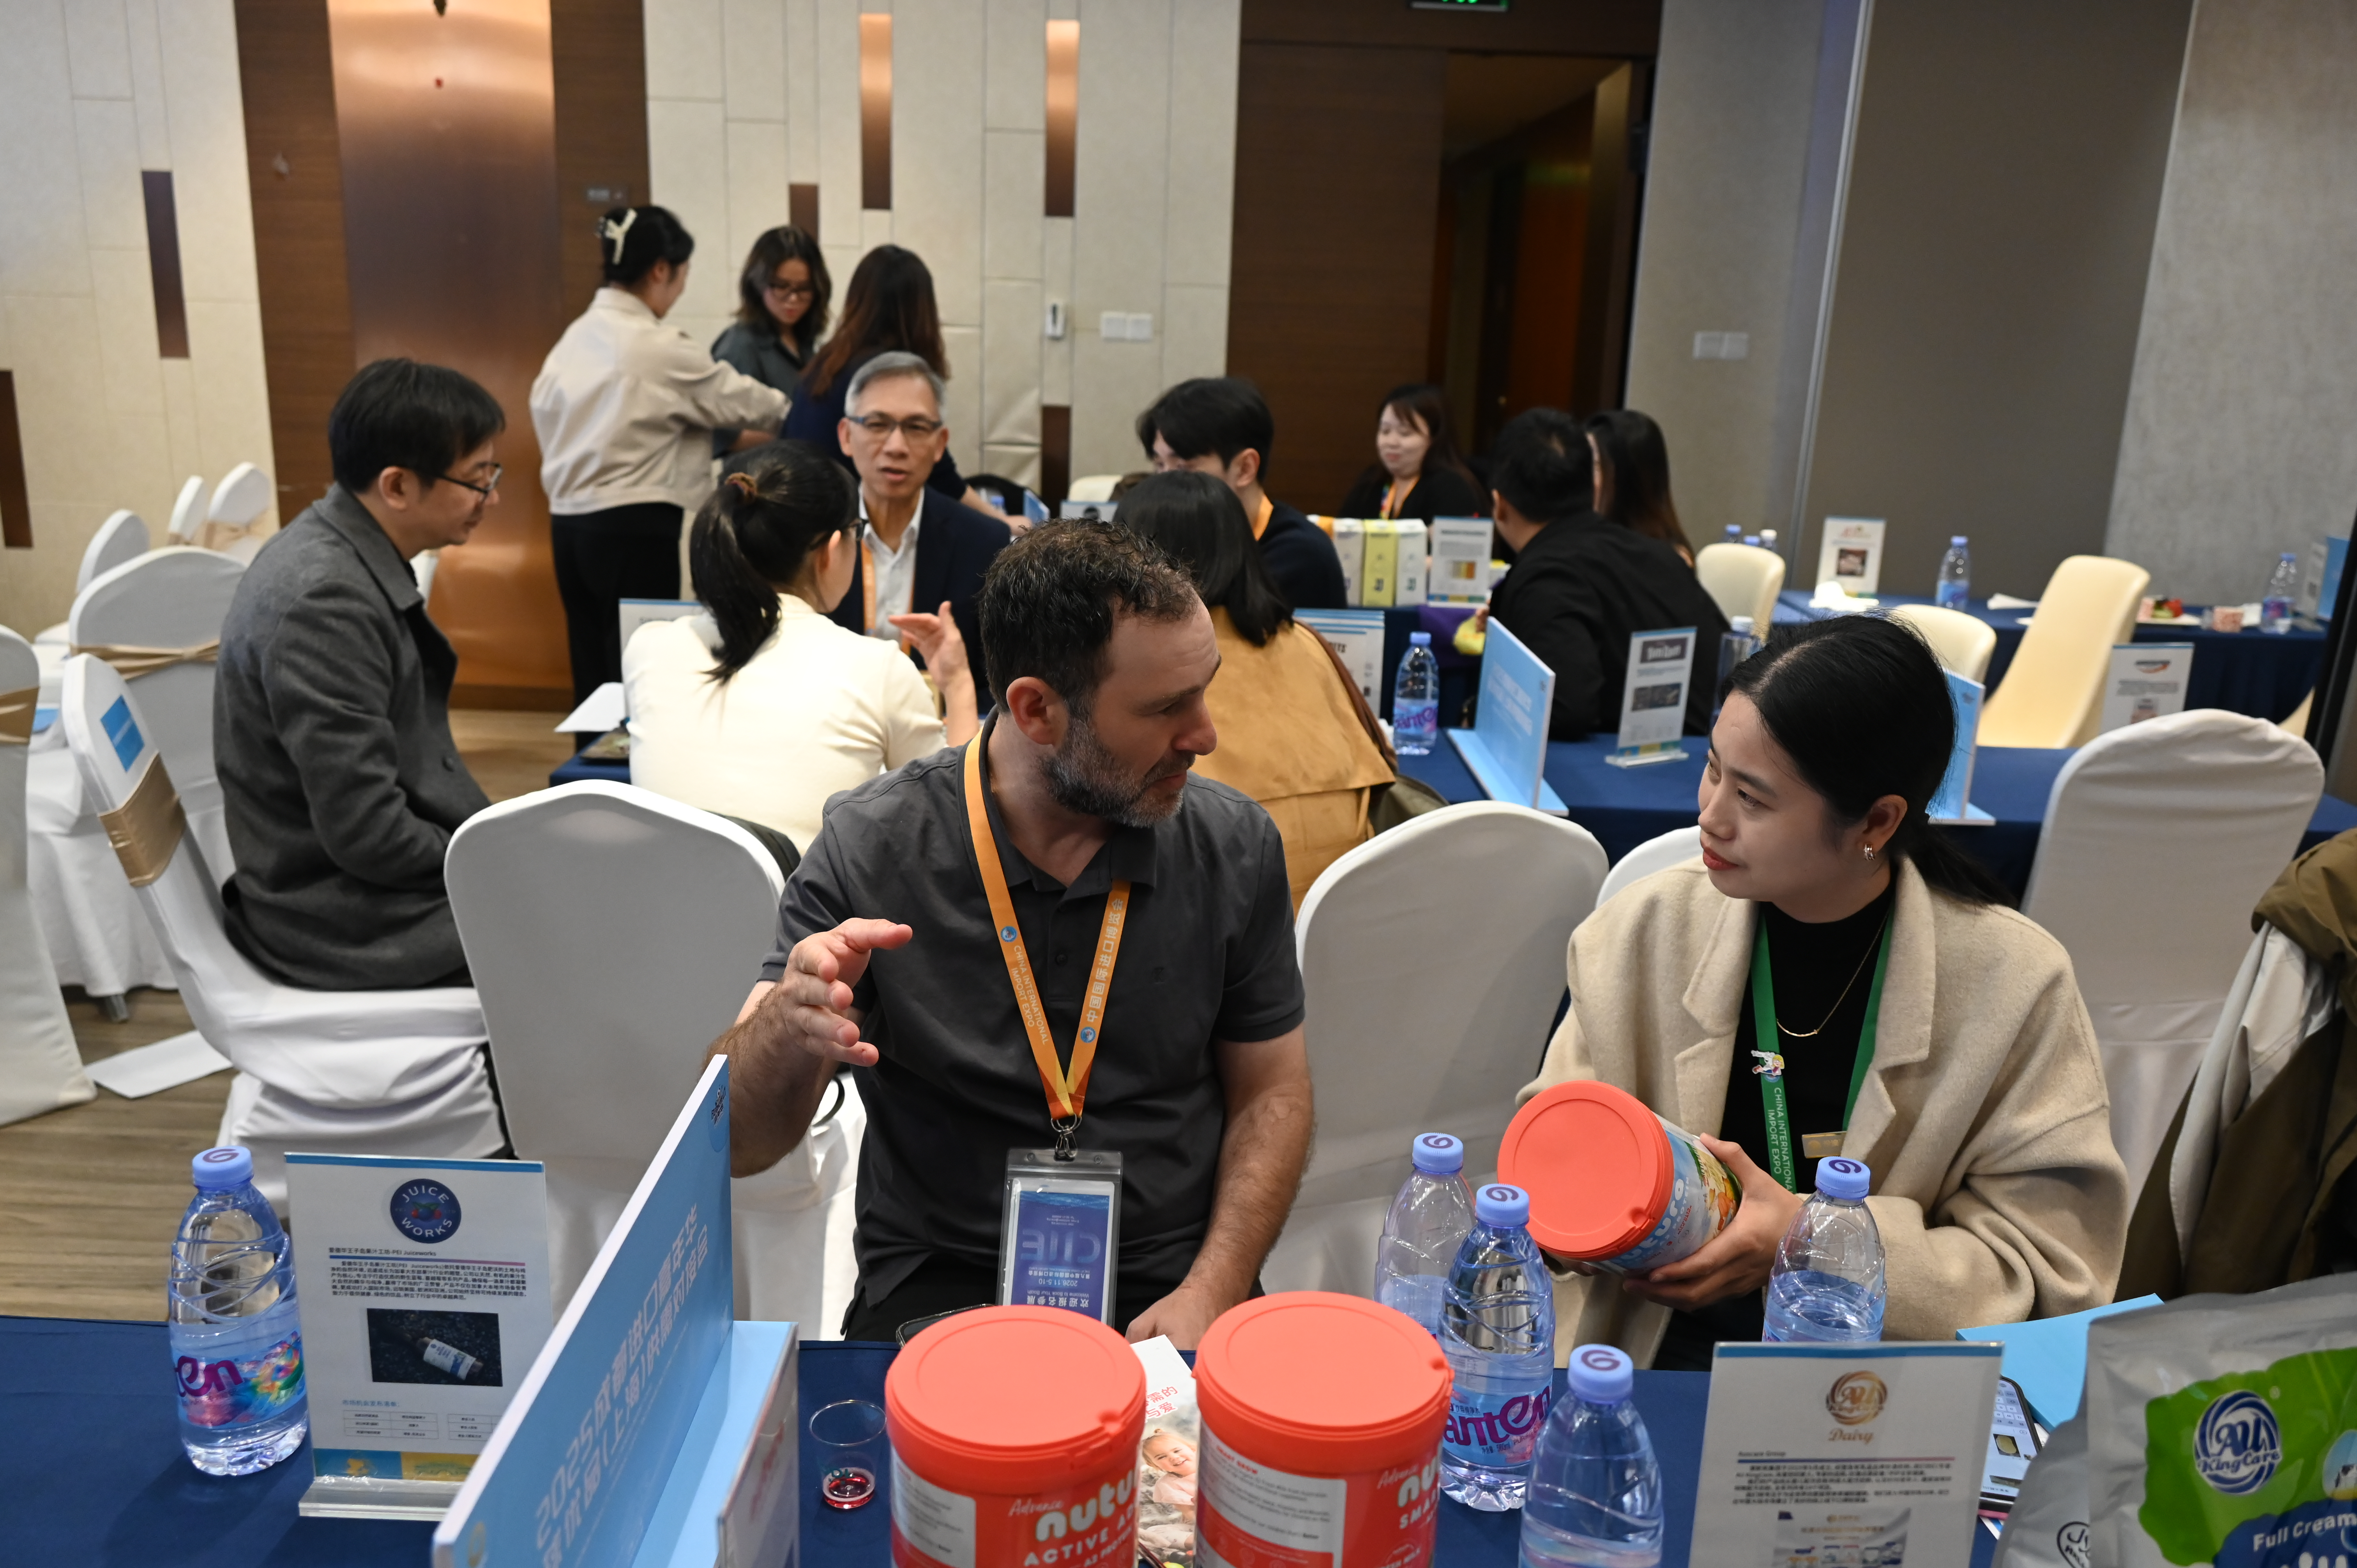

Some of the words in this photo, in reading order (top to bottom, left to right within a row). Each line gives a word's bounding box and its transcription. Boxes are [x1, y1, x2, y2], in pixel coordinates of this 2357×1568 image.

[1087, 898, 1123, 1023] 中国国际进口博览会
[1011, 968, 1028, 1002] IMPORT
[1022, 1003, 1035, 1028] EXPO
[1014, 945, 1026, 973] CHINA
[1024, 974, 1048, 1045] INTERNATIONAL
[1774, 1087, 1783, 1114] CHINA
[1767, 1109, 1777, 1146] IMPORT
[1771, 1148, 1782, 1174] EXPO
[1777, 1115, 1793, 1194] INTERNATIONA
[402, 1185, 449, 1204] JUICE
[401, 1217, 452, 1238] WORKS
[1622, 1179, 1684, 1259] utura
[1027, 1295, 1088, 1308] 欢迎报名参展
[537, 1202, 697, 1550] 2025成都进口嘉年华
[1443, 1385, 1550, 1446] anten
[2197, 1451, 2280, 1473] KingCare
[1024, 1527, 1109, 1567] ACTIVE
[2253, 1527, 2288, 1552] Full
[2293, 1513, 2357, 1539] Cream
